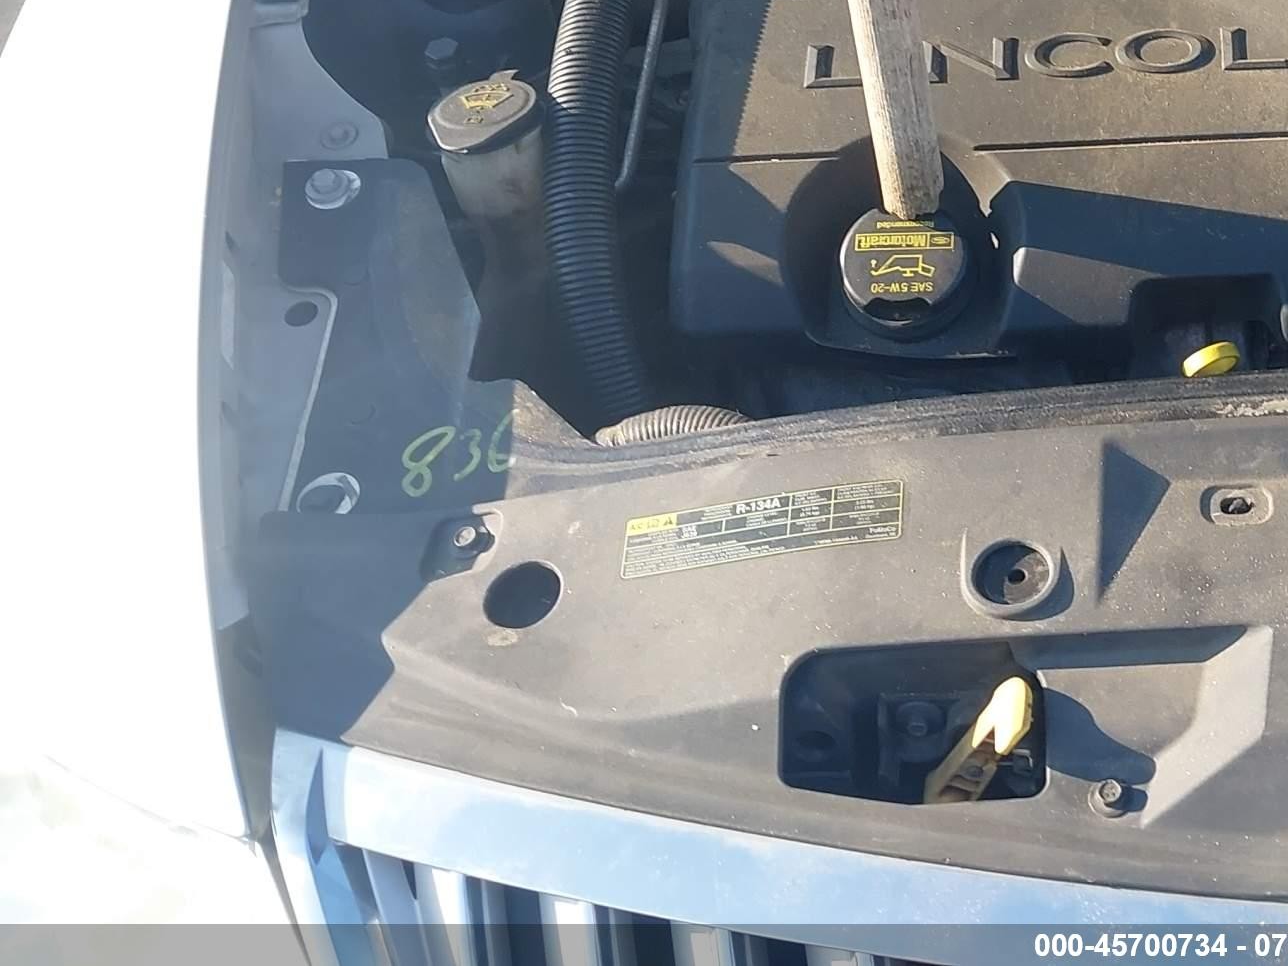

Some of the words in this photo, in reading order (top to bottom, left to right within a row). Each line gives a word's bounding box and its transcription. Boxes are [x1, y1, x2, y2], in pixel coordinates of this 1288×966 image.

[860, 235, 926, 247] Motorcraft
[870, 282, 908, 293] 5W-20
[910, 282, 933, 293] SAE
[735, 499, 782, 514] R-134A
